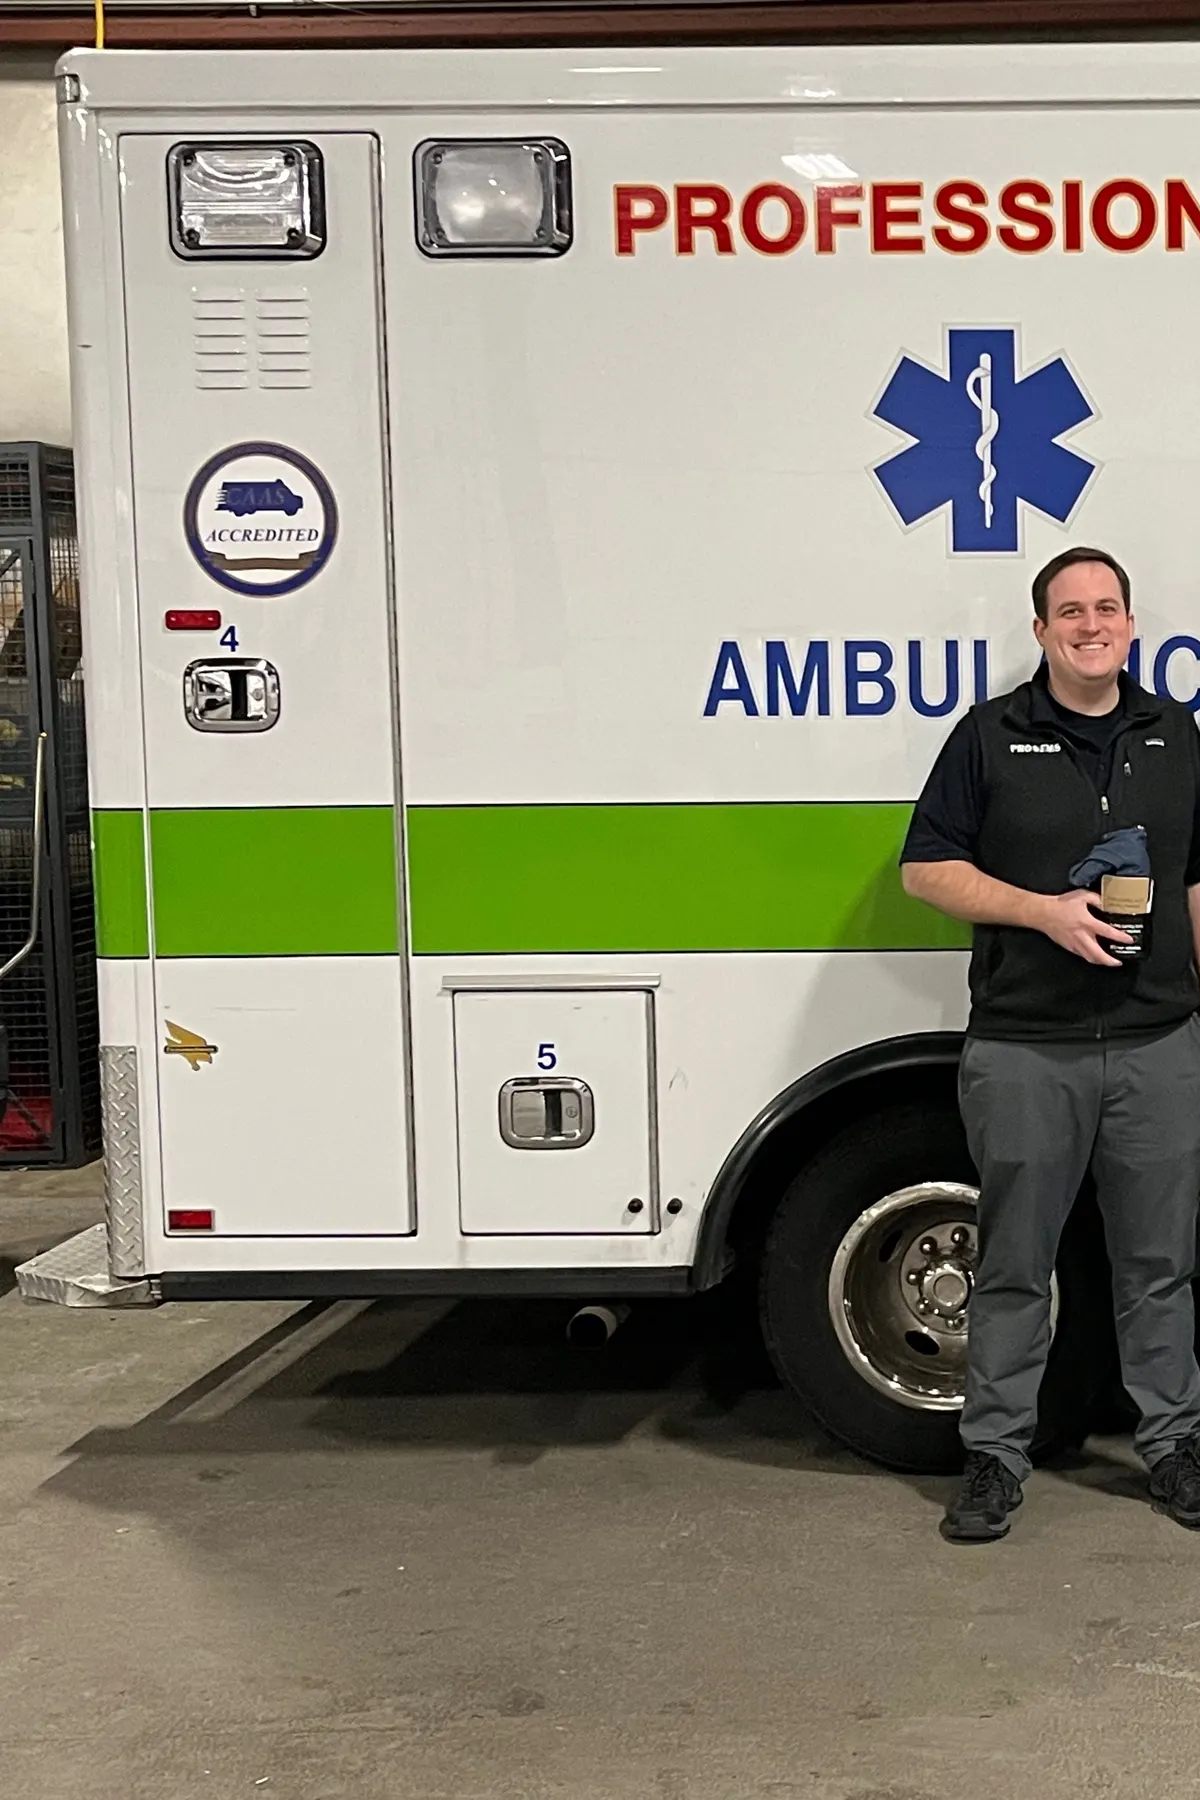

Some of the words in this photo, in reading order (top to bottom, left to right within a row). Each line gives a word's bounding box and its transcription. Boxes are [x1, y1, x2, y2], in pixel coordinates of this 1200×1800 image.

[206, 528, 320, 543] ACCREDITED
[219, 625, 240, 653] 4
[537, 1043, 557, 1070] 5
